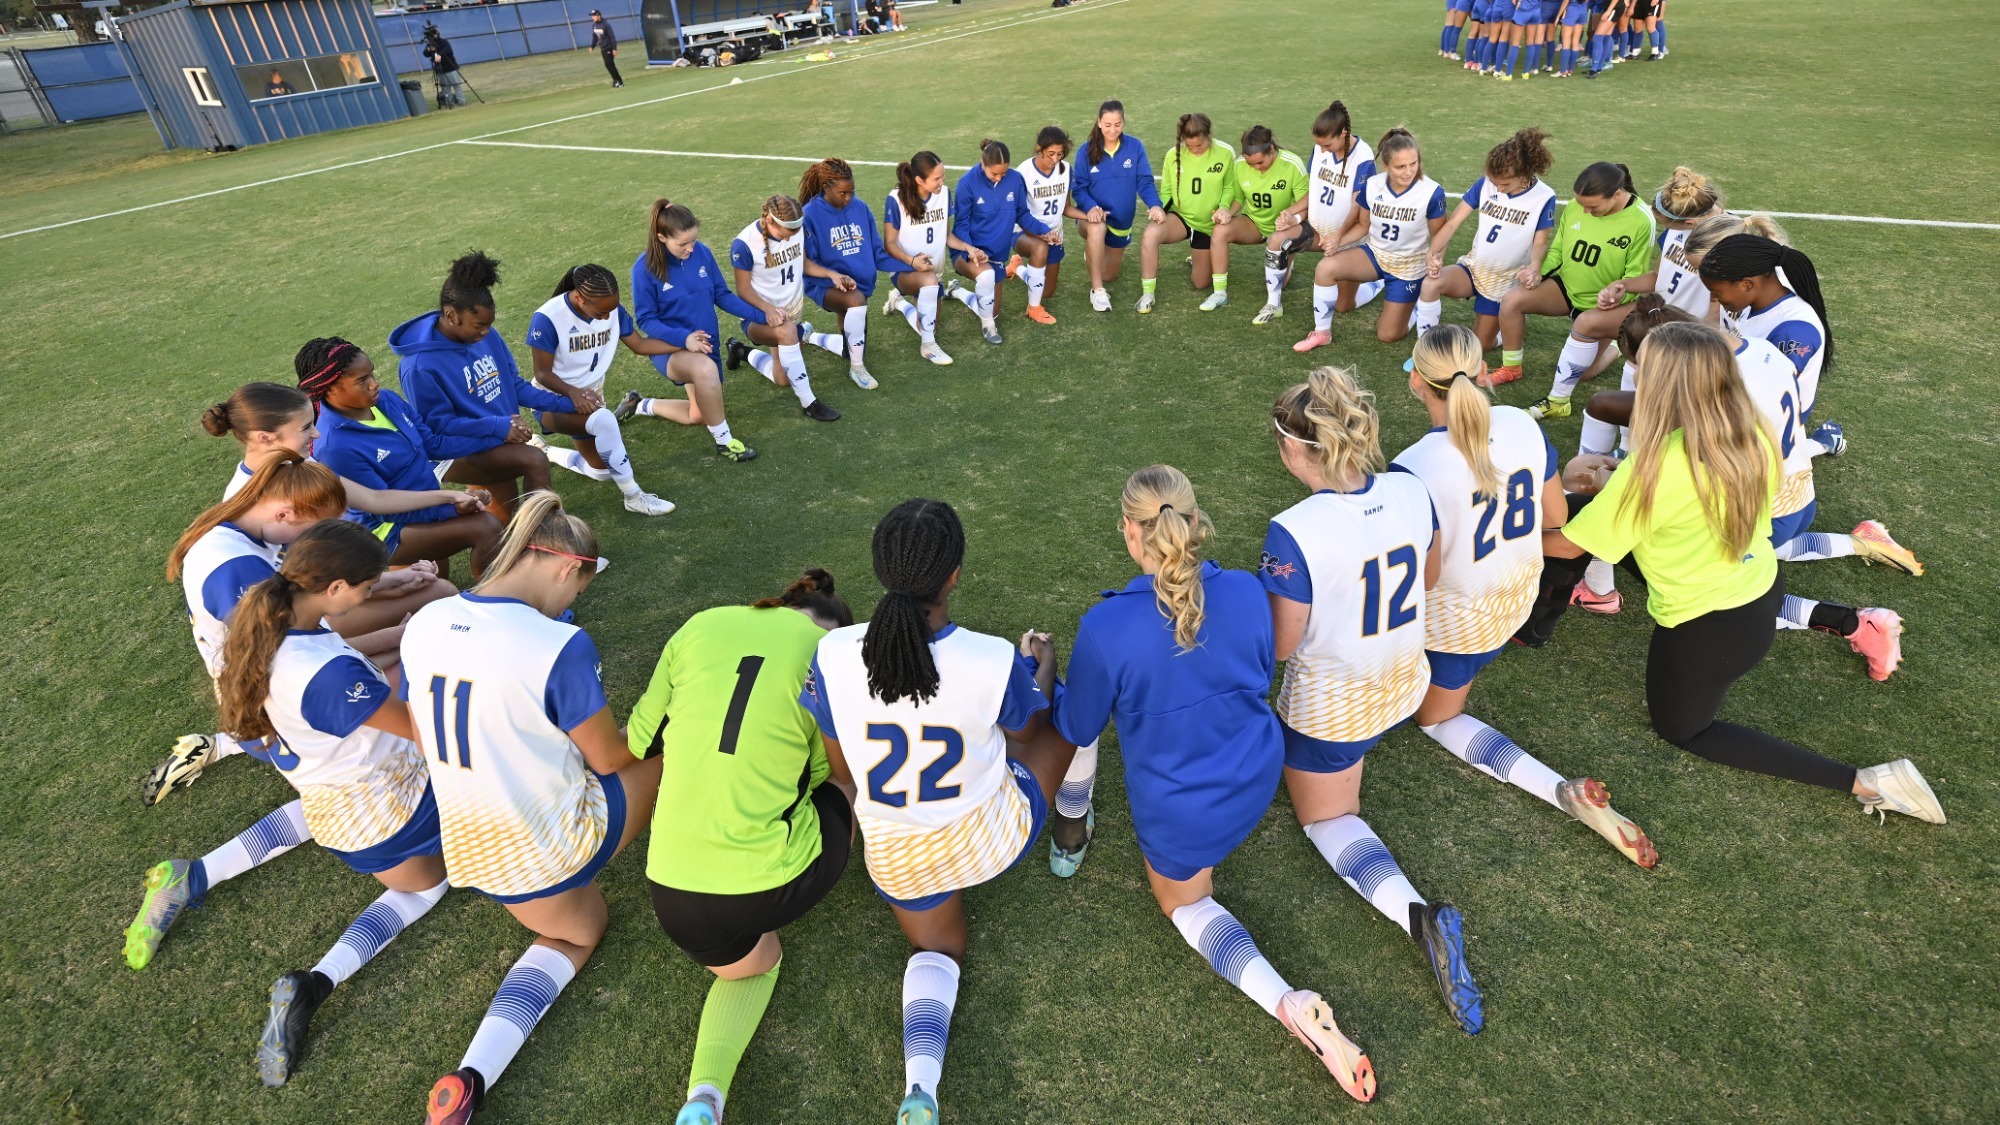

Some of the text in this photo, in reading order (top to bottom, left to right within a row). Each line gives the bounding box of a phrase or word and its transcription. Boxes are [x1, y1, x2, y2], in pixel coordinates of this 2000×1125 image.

[1033, 182, 1065, 199] ANGELO STATE
[1191, 177, 1201, 194] 0
[1252, 192, 1272, 208] 99
[1320, 186, 1335, 206] 20
[1043, 199, 1058, 215] 26
[1372, 202, 1417, 221] ANGELO STATE
[1480, 200, 1508, 220] ANGELO
[1505, 208, 1530, 226] STATE
[926, 226, 934, 244] 8
[1381, 222, 1400, 241] 23
[1486, 224, 1502, 243] 6
[1571, 239, 1602, 267] 00
[781, 265, 794, 285] 14
[1667, 271, 1683, 294] 5
[569, 333, 596, 353] ANGELO
[477, 375, 501, 397] STATE
[1472, 467, 1535, 563] 28
[1360, 543, 1417, 638] 12
[718, 655, 765, 755] 1
[428, 673, 474, 771] 11
[865, 721, 965, 809] 22
